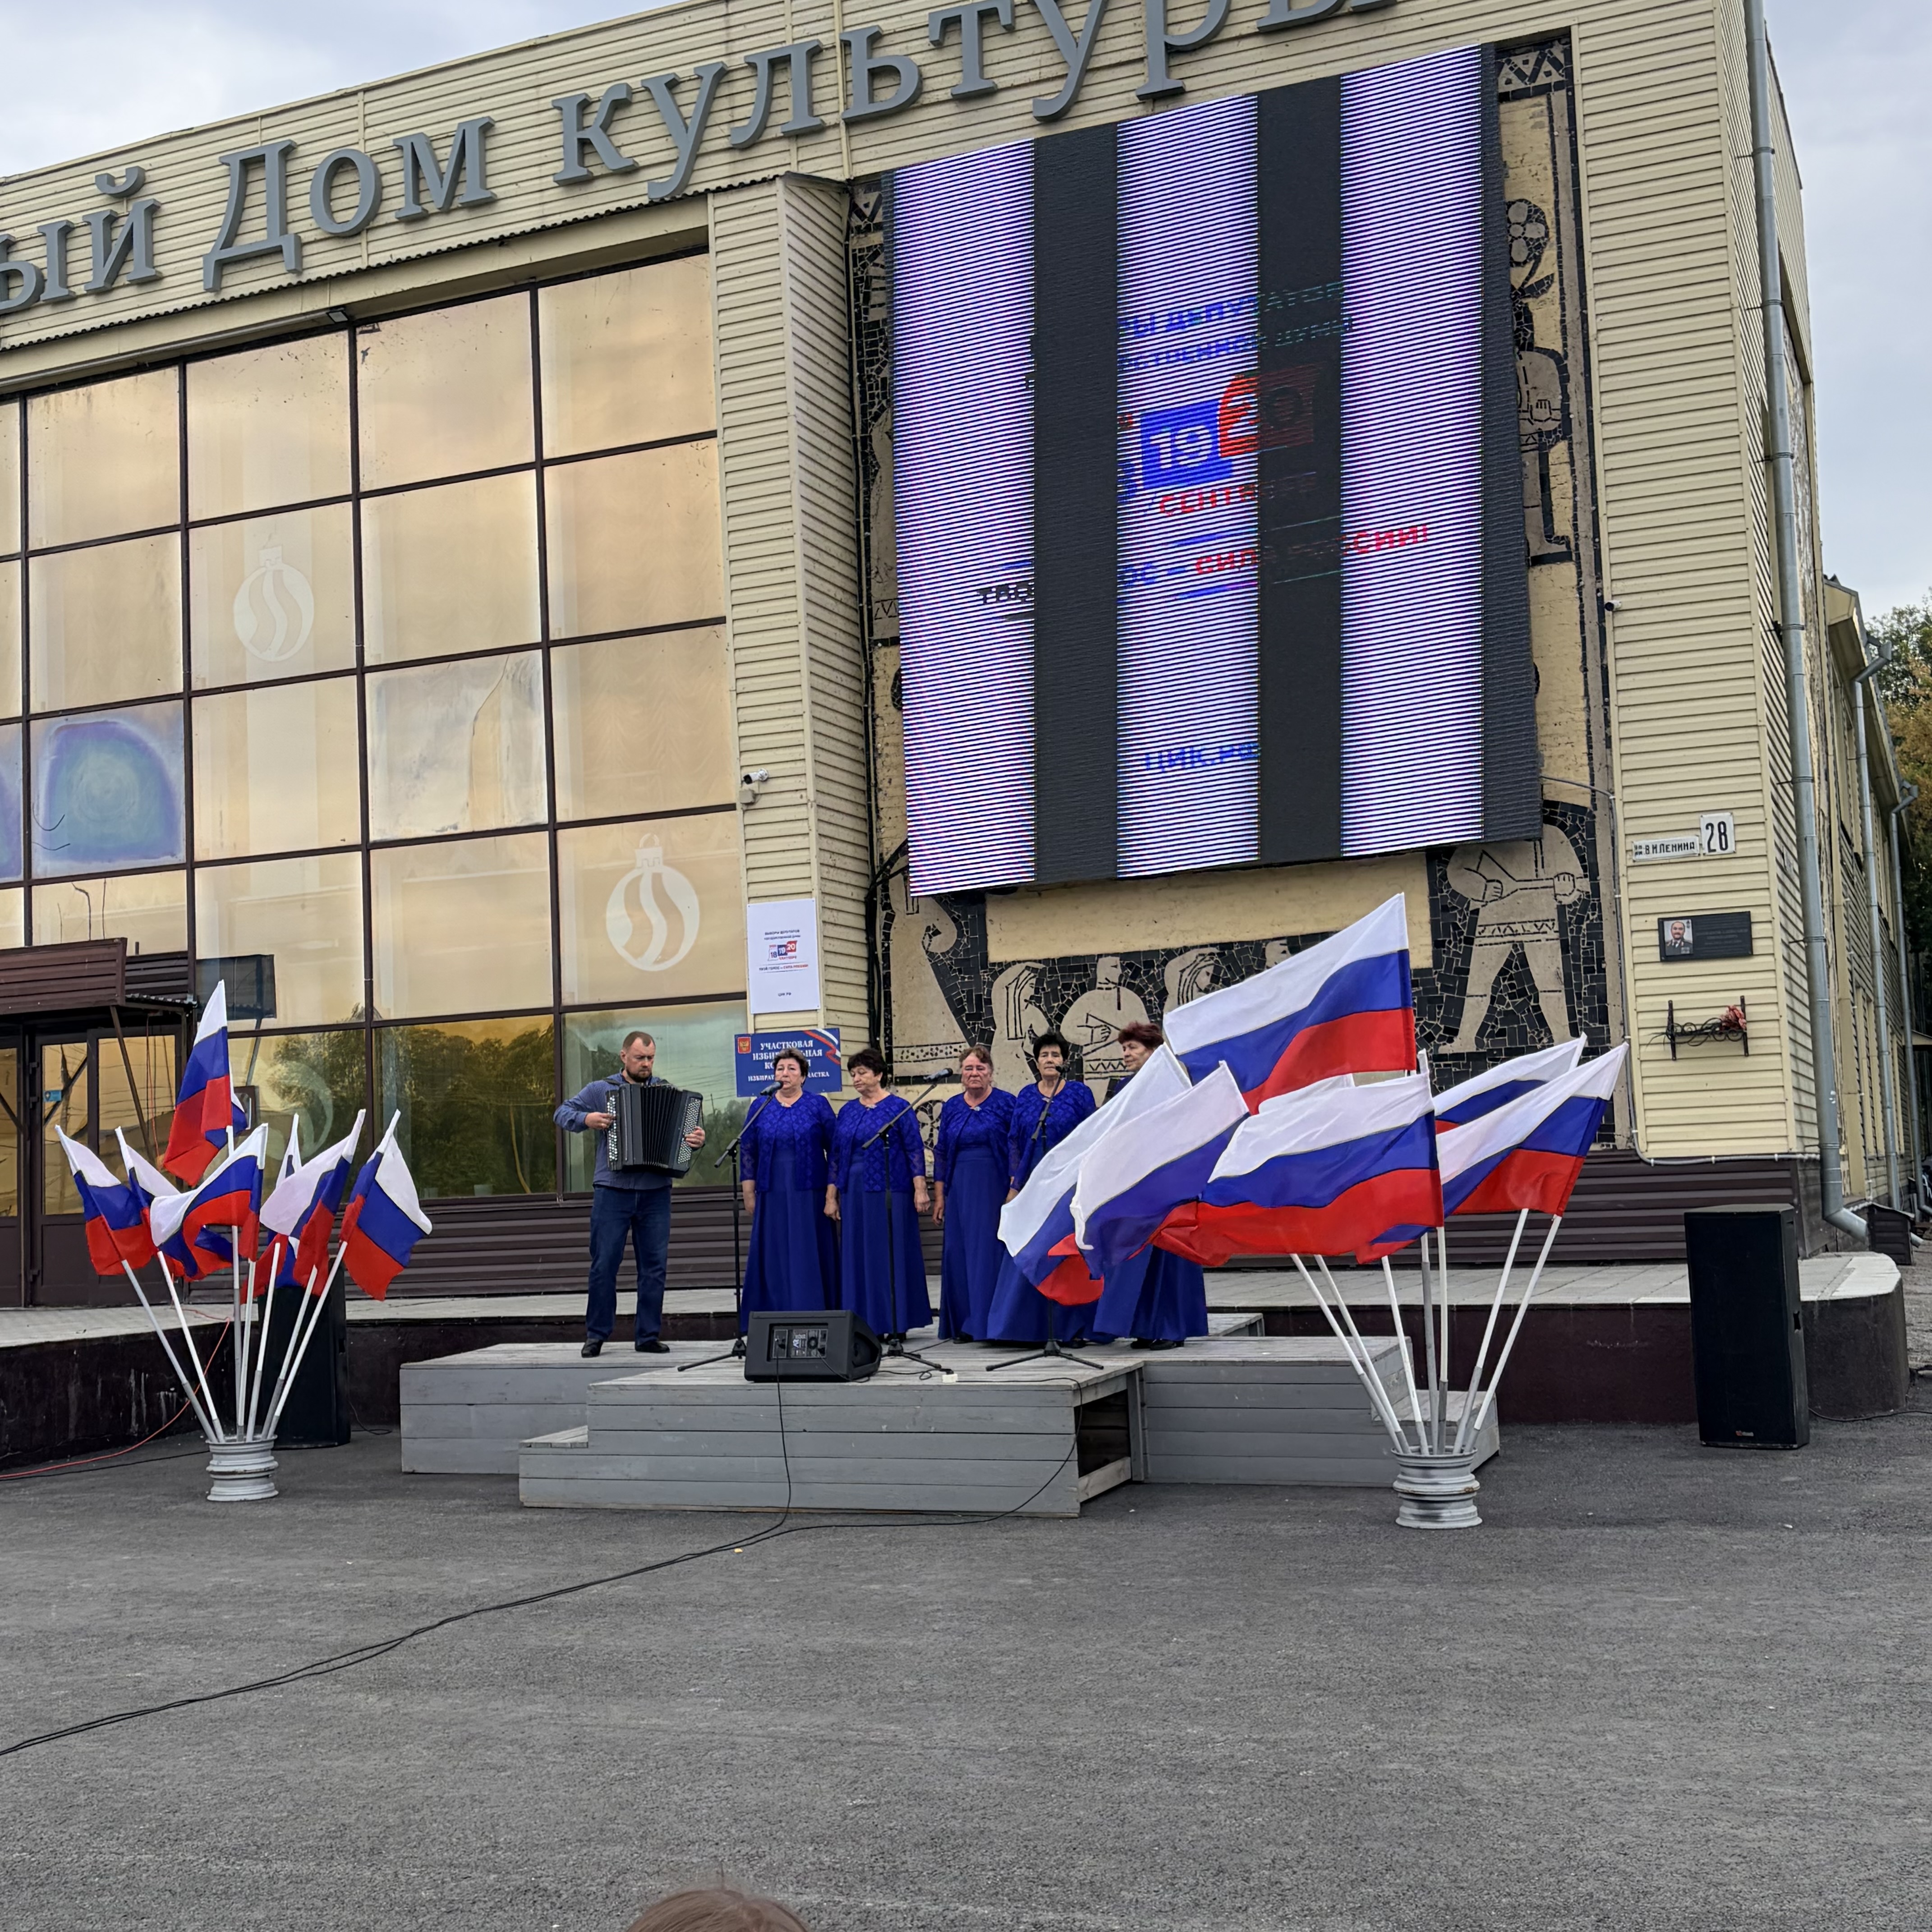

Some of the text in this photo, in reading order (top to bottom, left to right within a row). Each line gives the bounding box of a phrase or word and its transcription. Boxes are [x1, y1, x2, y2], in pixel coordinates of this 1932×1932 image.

[202, 116, 497, 292] Дом
[1150, 424, 1213, 470] 19
[1705, 821, 1728, 853] 28
[760, 1040, 814, 1050] УЧАСТКОВАЯ
